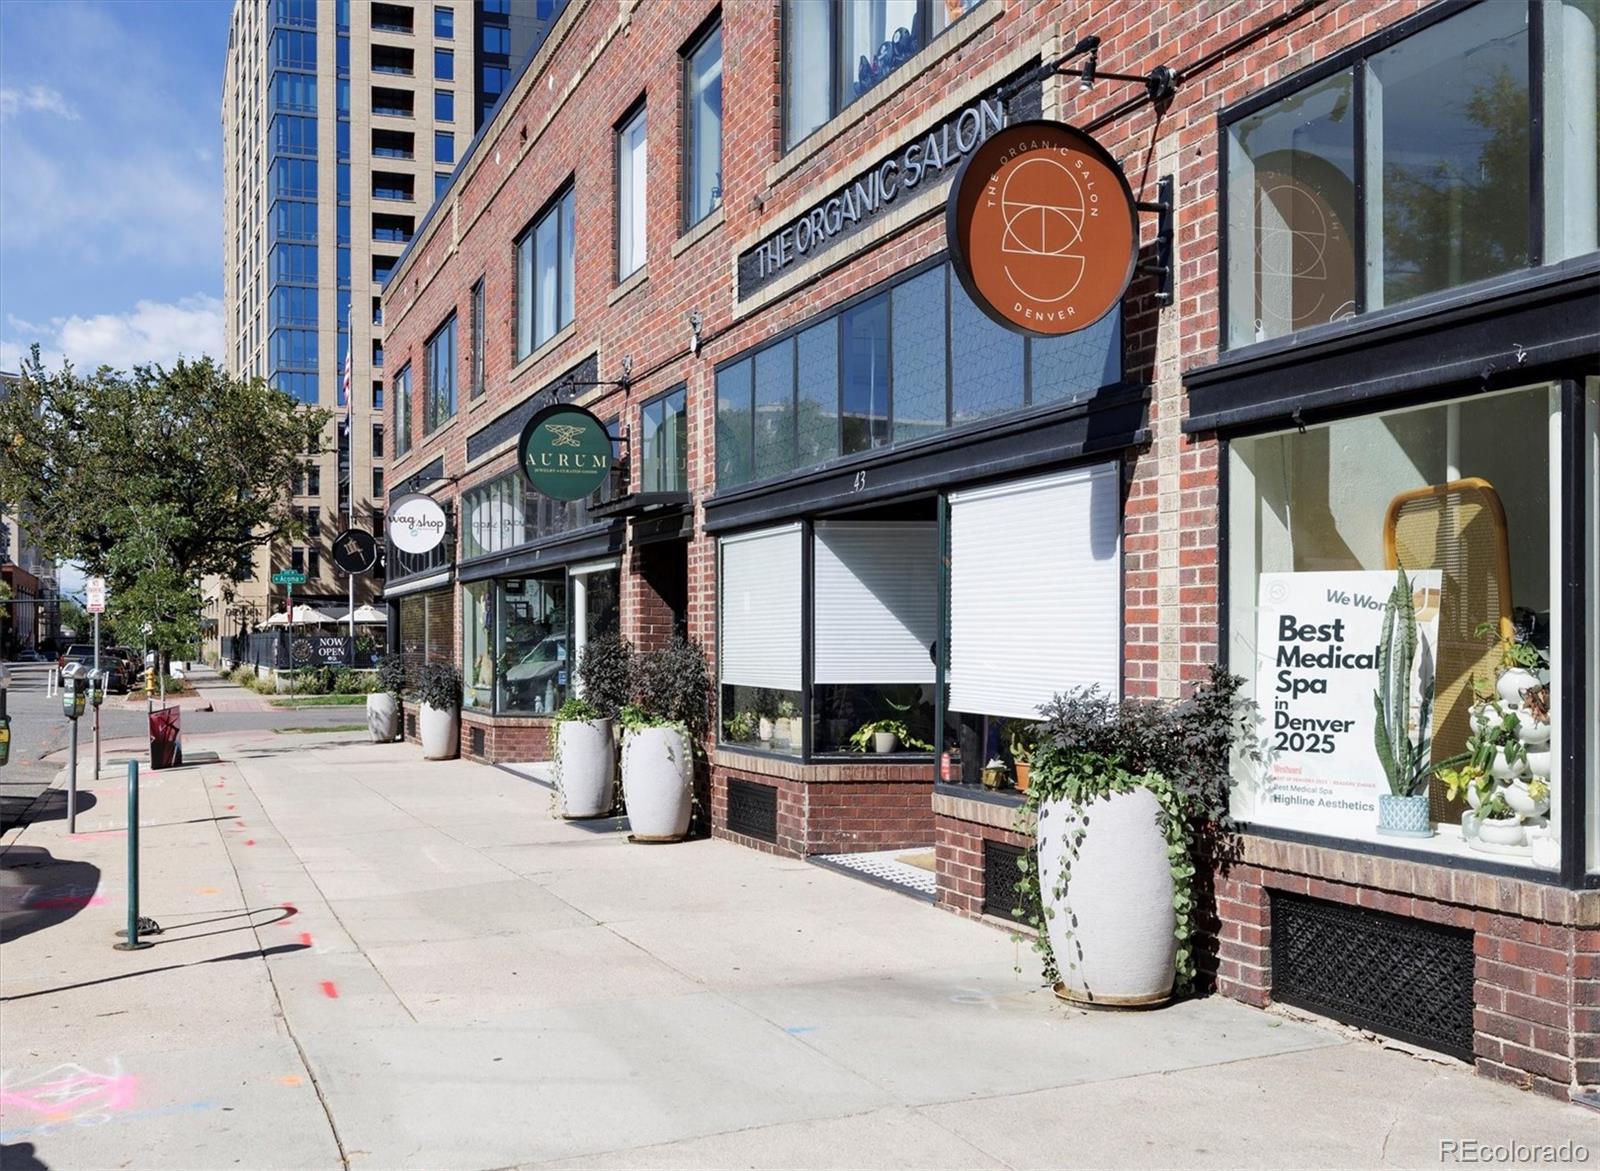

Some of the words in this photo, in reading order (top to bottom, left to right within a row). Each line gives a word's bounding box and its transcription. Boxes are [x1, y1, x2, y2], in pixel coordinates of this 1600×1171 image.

[755, 231, 794, 278] THE
[796, 160, 898, 253] ORGANIC
[904, 99, 1003, 188] SALON
[987, 173, 999, 208] THE
[1000, 140, 1069, 166] ORGANIC
[1075, 159, 1099, 217] SALON
[1014, 302, 1076, 321] DENVER
[525, 453, 607, 468] AURUM
[854, 470, 866, 492] 43
[388, 516, 415, 530] wag
[416, 513, 444, 534] shop
[1326, 589, 1351, 606] We
[1278, 614, 1345, 642] Best
[318, 647, 345, 656] OPEN
[320, 637, 344, 647] NOW
[1276, 645, 1381, 670] Medical
[1275, 670, 1327, 699] Spa
[1275, 696, 1289, 710] in
[1274, 710, 1355, 733] Denver
[1274, 731, 1336, 754] 2025
[1290, 784, 1318, 794] Medical
[1319, 786, 1334, 796] Spa
[1273, 794, 1315, 806] Highline
[1317, 798, 1376, 812] Aesthetics
